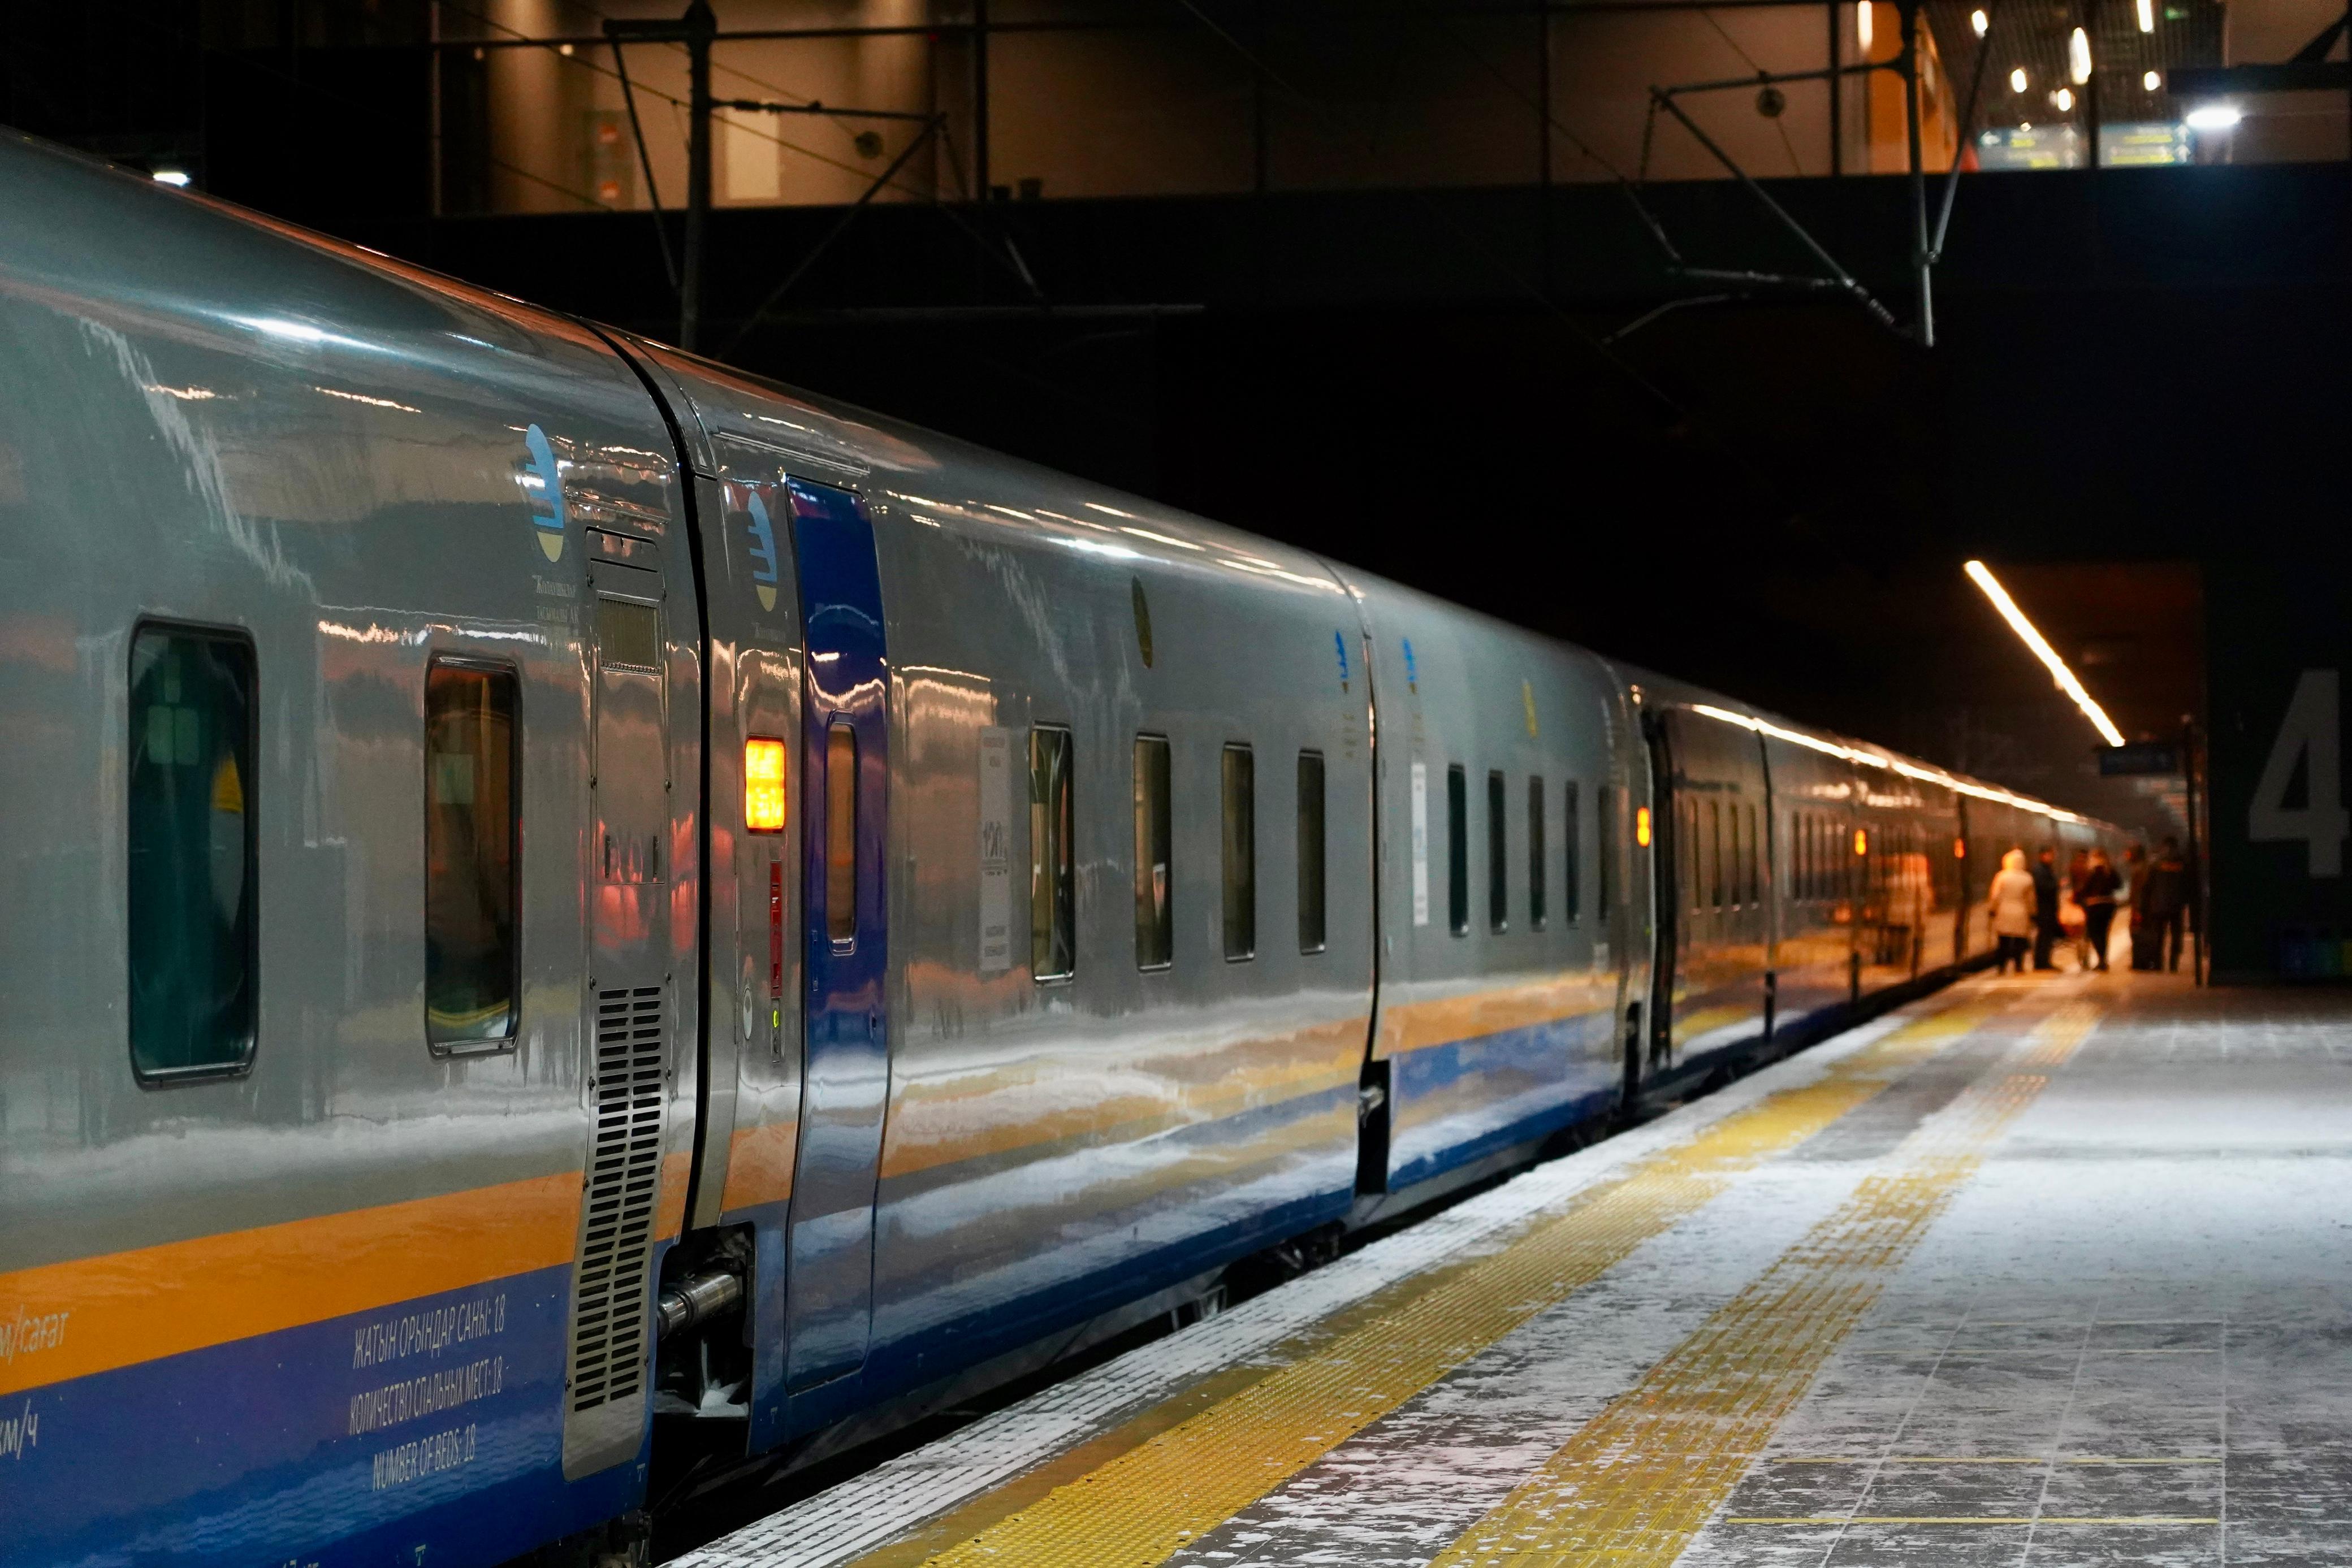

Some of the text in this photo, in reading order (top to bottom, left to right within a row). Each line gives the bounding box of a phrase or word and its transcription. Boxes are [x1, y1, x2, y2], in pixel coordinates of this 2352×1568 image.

[2249, 668, 2350, 877] 4
[353, 1293, 505, 1370] ЖАТЫН ОРЫНДАР САНЫ: 18
[349, 1355, 502, 1436] КОЛИЧЕСТВО СПАЛЬНЫХ МЕСТ: 18
[373, 1423, 475, 1492] NUMBER OF BEDS: 18
